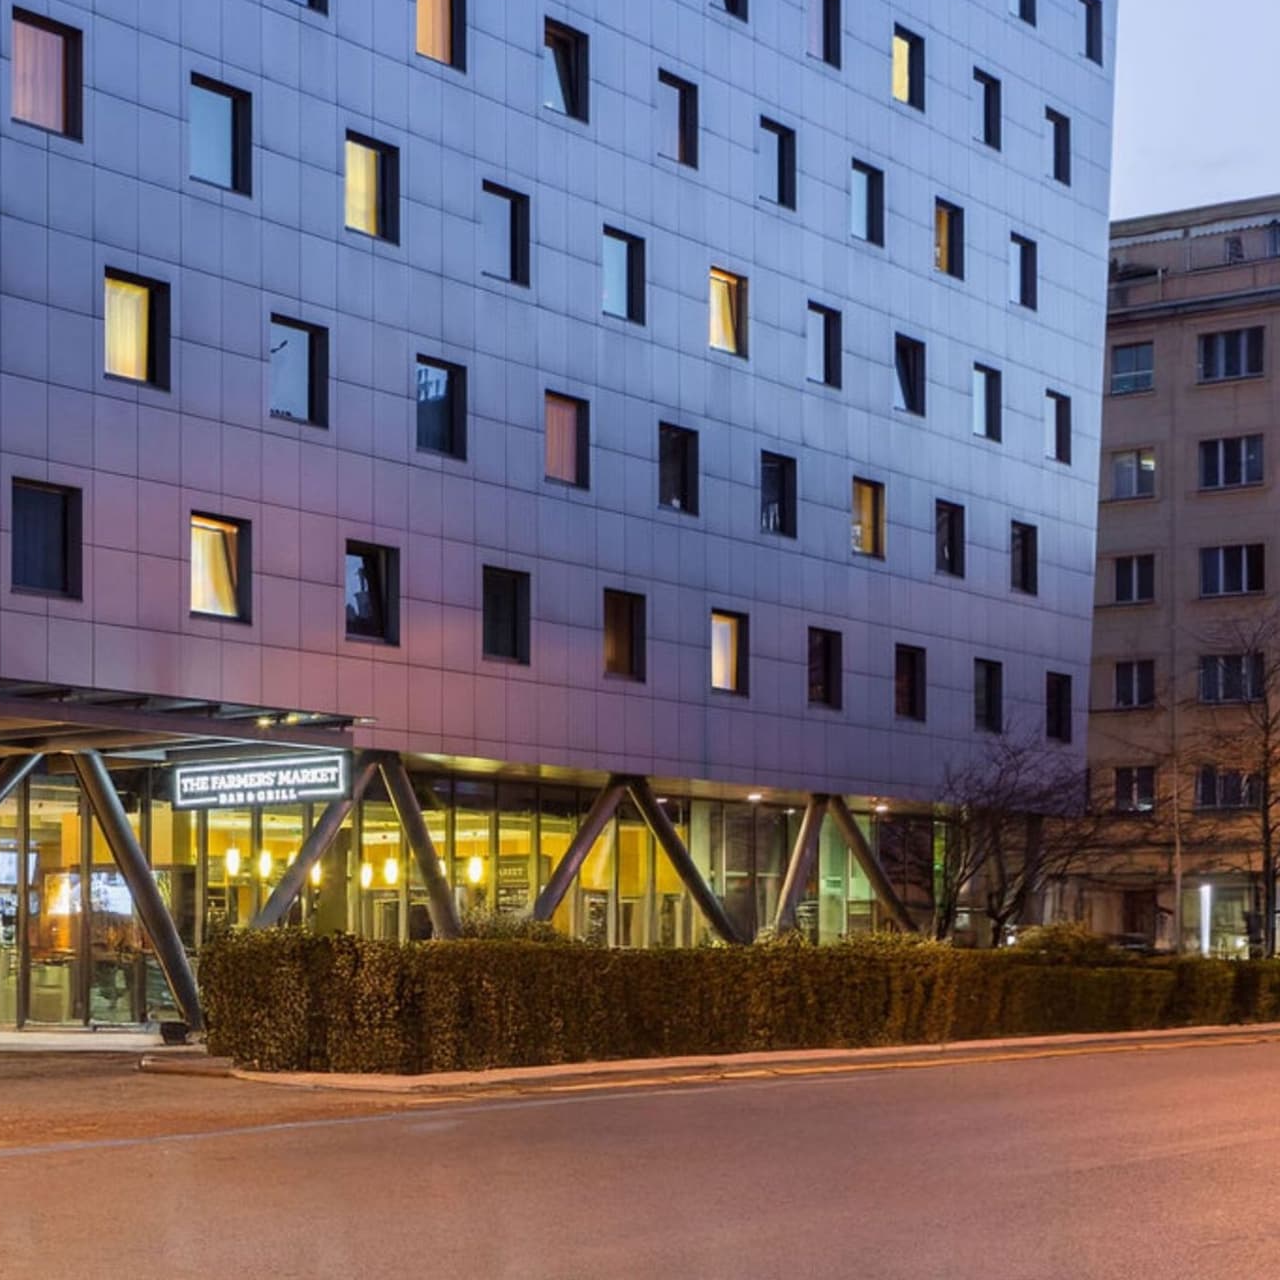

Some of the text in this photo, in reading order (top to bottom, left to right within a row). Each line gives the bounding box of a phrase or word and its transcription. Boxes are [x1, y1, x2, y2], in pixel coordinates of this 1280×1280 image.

[181, 776, 209, 792] THE
[277, 767, 339, 785] MARKET
[218, 791, 245, 805] BAR
[257, 788, 297, 802] GRILL
